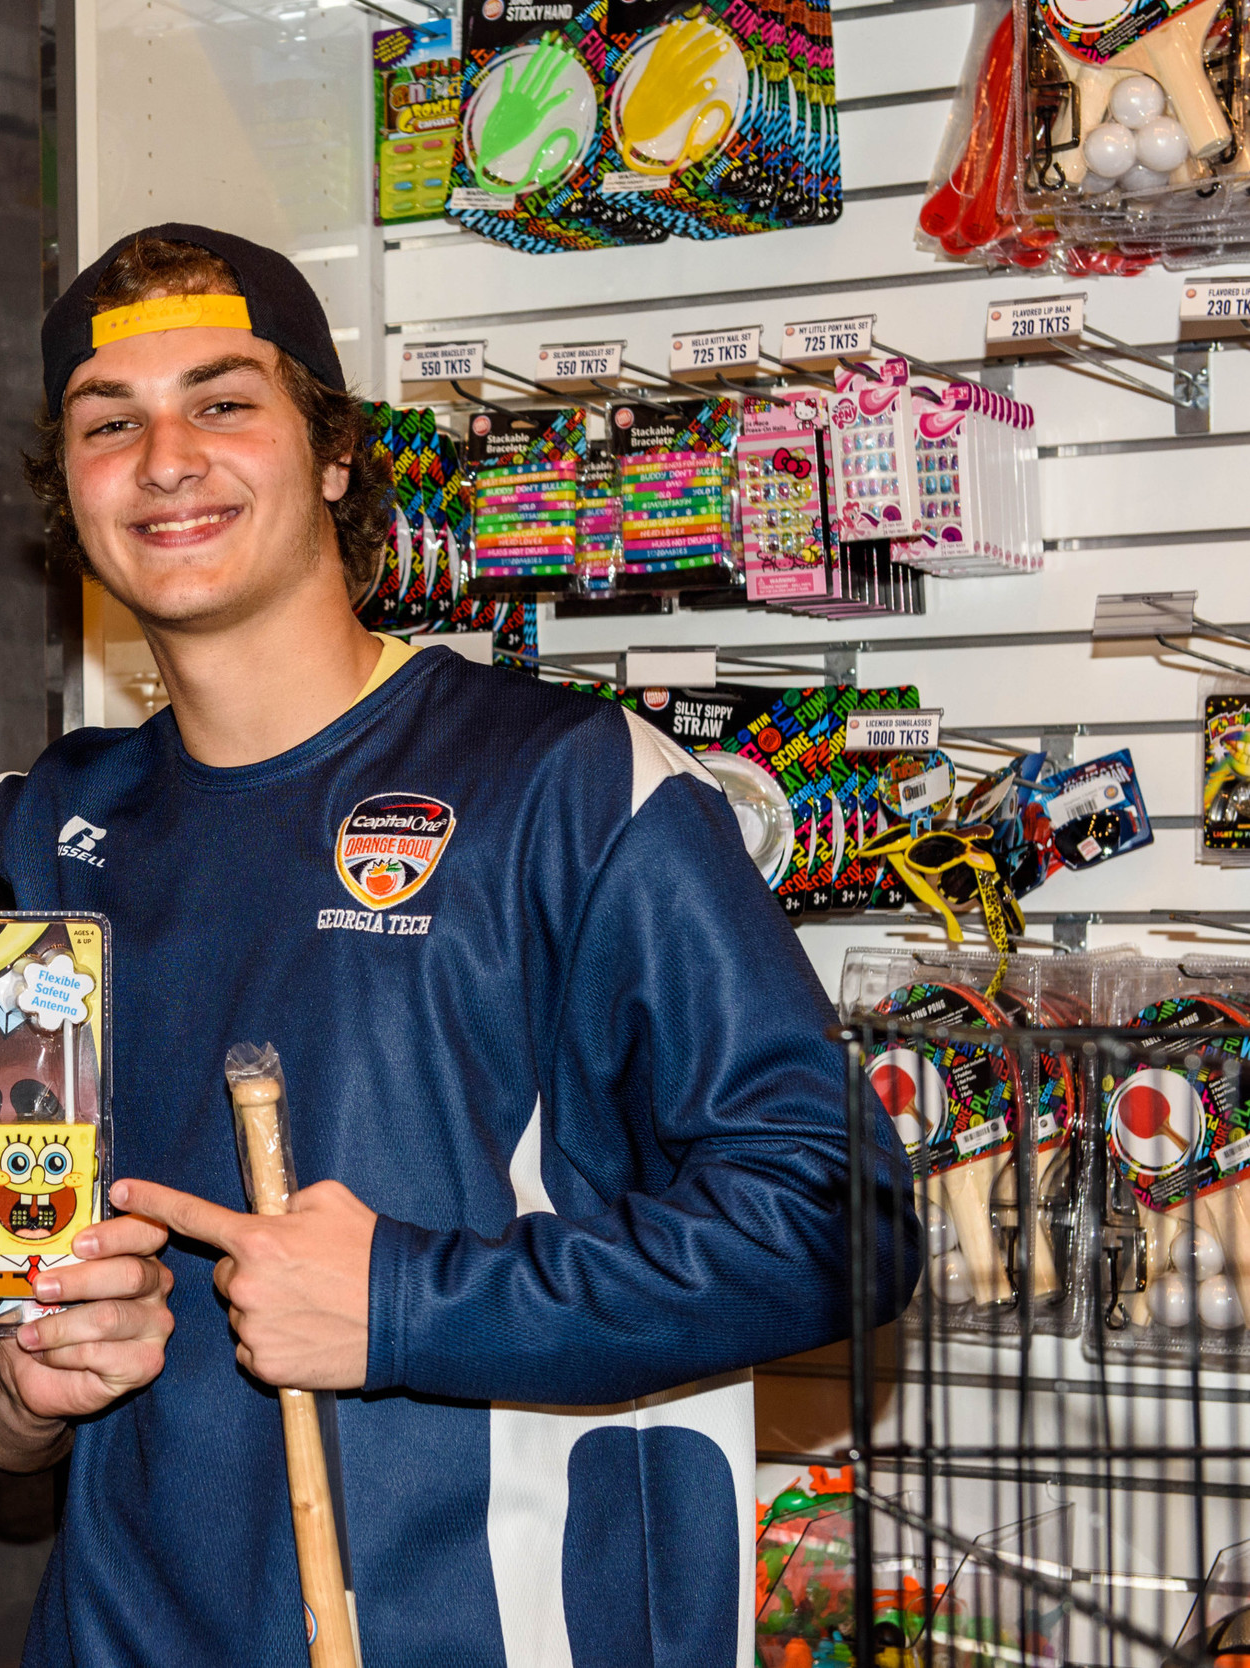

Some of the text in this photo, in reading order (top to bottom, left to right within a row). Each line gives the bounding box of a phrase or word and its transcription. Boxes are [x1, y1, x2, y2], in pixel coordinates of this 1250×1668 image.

[506, 7, 544, 22] STICKY
[544, 4, 573, 20] HAND
[1208, 288, 1239, 297] FLAVORED
[1012, 305, 1072, 318] FLAVORED LIP BALM
[1207, 299, 1250, 316] 230 TK
[799, 321, 869, 335] MY LITTLE PONY NAIL SET
[1012, 316, 1070, 336] 230 TKTS
[692, 333, 752, 347] HELLO KITTY NAIL SET
[805, 333, 859, 352] 725 TKTS
[417, 348, 476, 359] SILICONE BRACELET SET
[553, 348, 615, 359] SILICONE BRACELET SET
[693, 345, 747, 365] 725 TKTS
[421, 359, 471, 376] 550 TKTS
[556, 358, 607, 376] 550 TKTS
[487, 433, 530, 444] Stackable
[631, 425, 675, 438] Stackable
[486, 442, 527, 454] Bracelets
[631, 434, 673, 447] Bracelets
[640, 472, 666, 481] BUDDY
[669, 469, 692, 478] DON'T
[485, 481, 568, 496] BUDDY DON'T BULLY
[674, 701, 733, 720] SILLY SIPPY
[673, 716, 724, 738] STRAW
[747, 712, 771, 735] WIN
[866, 719, 932, 727] LICENSED SUNGLASSES
[867, 730, 929, 745] 1000 TKTS
[771, 731, 813, 772] SCORE
[344, 837, 433, 862] ORANGE BOWL
[786, 897, 800, 910] 3+
[814, 892, 828, 905] 3+
[842, 890, 855, 903] 3+
[889, 891, 902, 903] 3+
[317, 908, 432, 935] GEORGIA TECH
[38, 969, 81, 990] Flexible
[34, 983, 71, 1002] Safety
[30, 996, 78, 1016] Antenna
[911, 1007, 927, 1022] PING
[928, 999, 946, 1015] PONG
[1179, 1012, 1199, 1028] PONG
